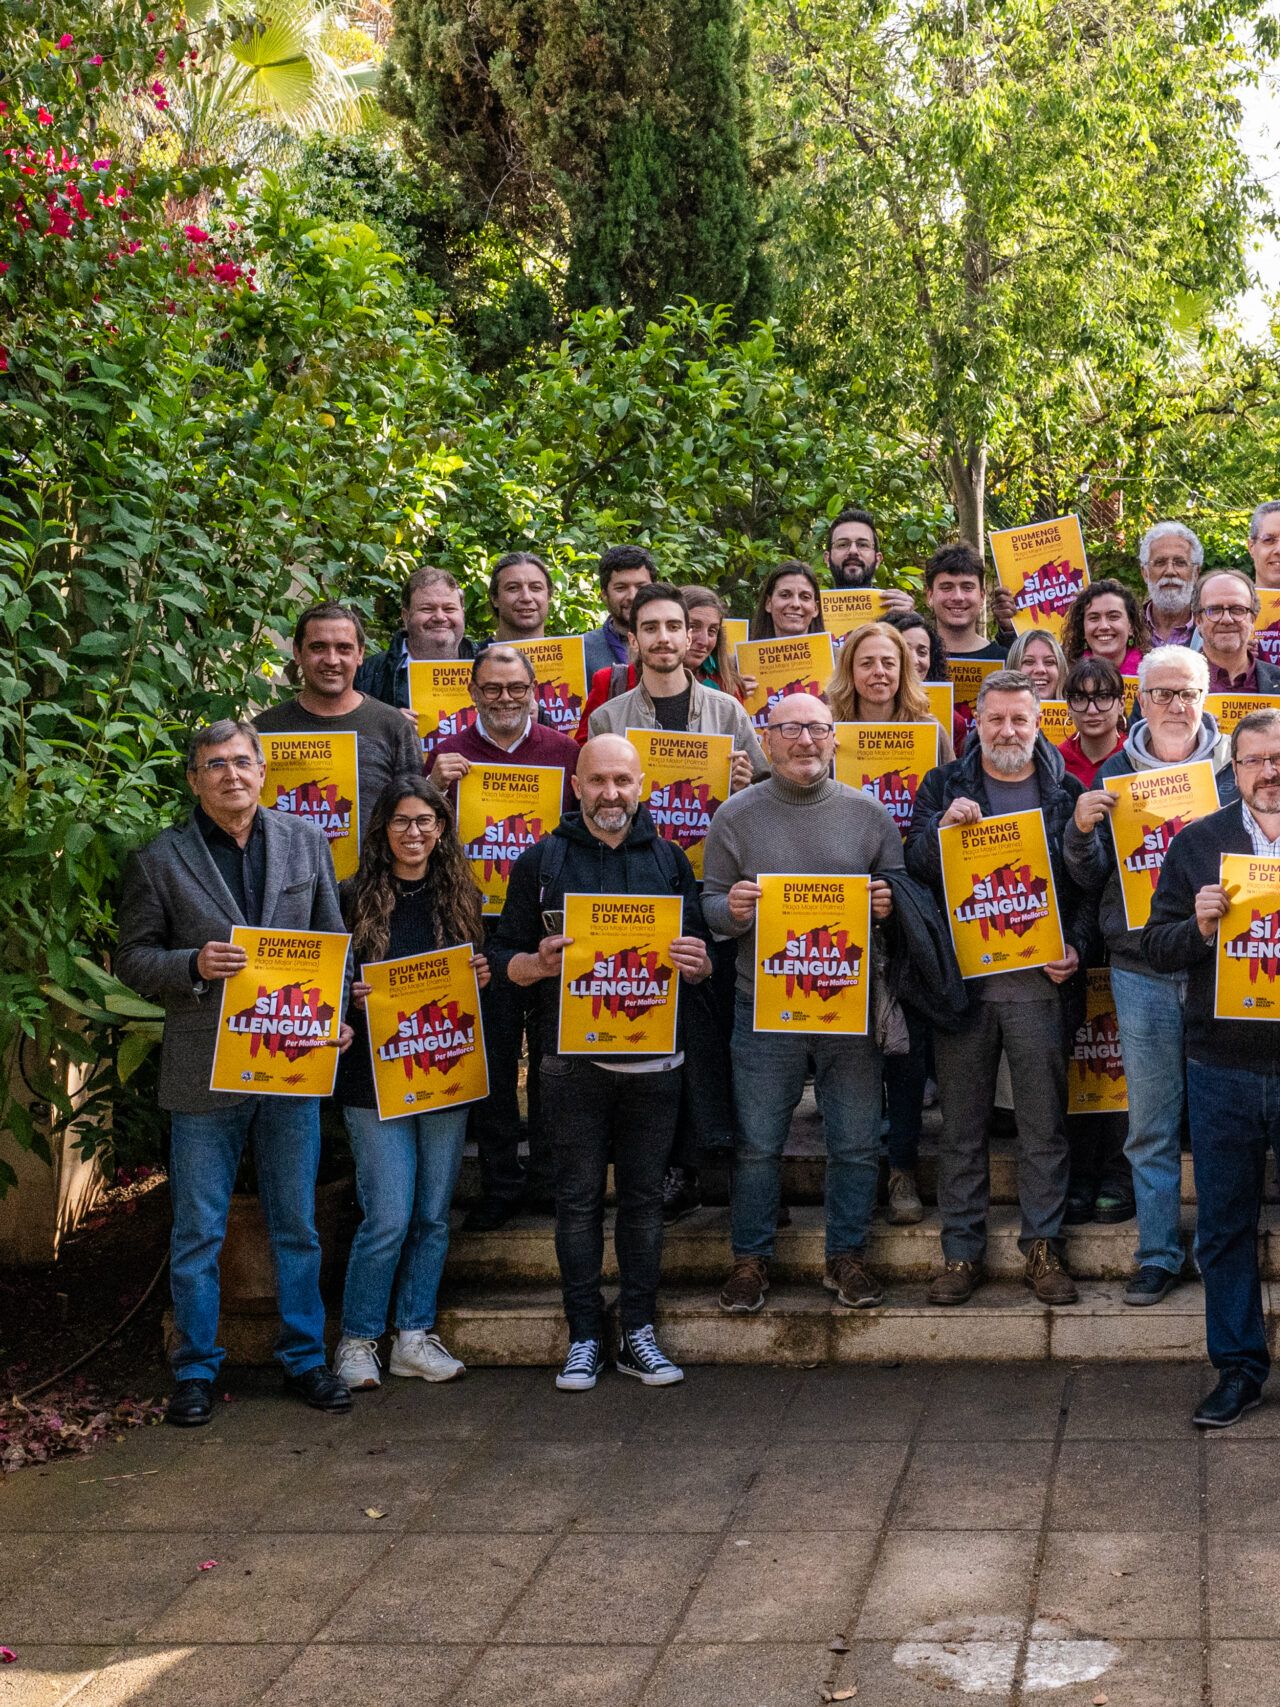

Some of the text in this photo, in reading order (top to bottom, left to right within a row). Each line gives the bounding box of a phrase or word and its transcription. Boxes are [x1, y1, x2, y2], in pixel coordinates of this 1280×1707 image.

[1011, 527, 1059, 544] DIUMENGE
[1013, 535, 1061, 552] 5 DE MAIG
[758, 642, 809, 655] DIUMENGE
[760, 651, 811, 664] 5 DE MAIG
[859, 731, 914, 739] DIUMENGE
[272, 741, 331, 750] DIUMENGE
[272, 751, 332, 760] 5 DE MAIG
[484, 772, 539, 782] DIUMENGE
[1131, 773, 1189, 791] DIUMENGE
[483, 781, 539, 792] 5 DE MAIG
[960, 821, 1018, 839] DIUMENGE
[962, 830, 1021, 849] 5 DE MAIG
[1249, 872, 1256, 881] 5
[1260, 873, 1275, 882] DE
[784, 883, 844, 892] DIUMENGE
[973, 875, 1027, 900] SÍ A LA
[784, 893, 845, 902] 5 DE MAIG
[592, 904, 655, 913] DIUMENGE
[955, 891, 1049, 922] LLENGUA!
[592, 914, 655, 923] 5 DE MAIG
[1250, 915, 1272, 939] SÍ
[258, 936, 322, 949] DIUMENGE
[786, 934, 841, 957] SÍ A LA
[257, 947, 322, 960] 5 DE MAIG
[389, 957, 448, 976] DIUMENGE
[593, 955, 649, 978] SÍ A LA
[764, 959, 861, 976] LLENGUA!
[390, 966, 450, 986] 5 DE MAIG
[570, 980, 669, 996] LLENGUA!
[255, 991, 312, 1016] SÍ A LA
[637, 998, 666, 1006] Mallorca
[228, 1015, 332, 1037] LLENGUA!
[398, 1012, 454, 1038] SÍ A LA
[379, 1026, 475, 1061] LLENGUA!
